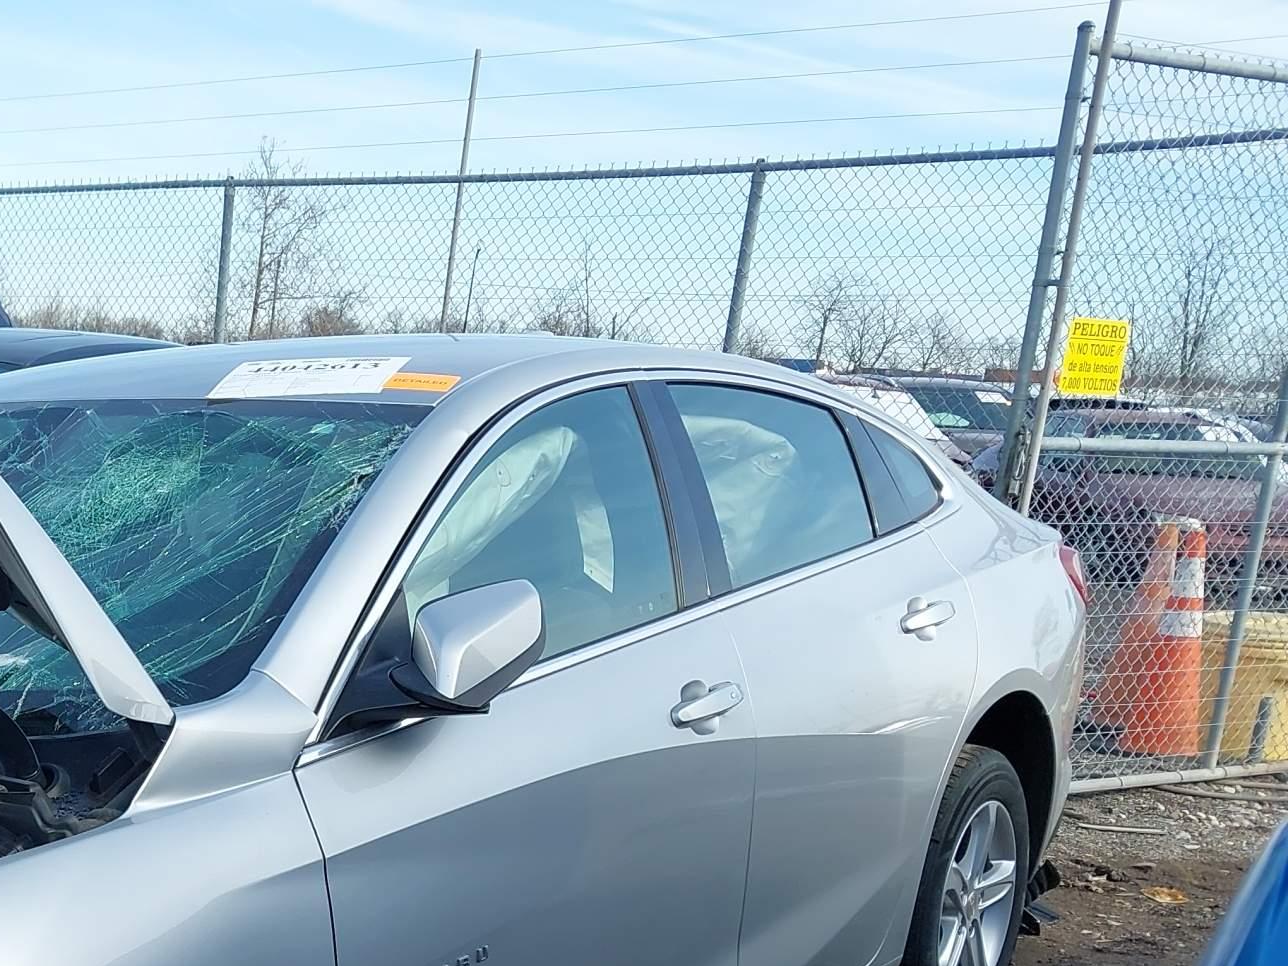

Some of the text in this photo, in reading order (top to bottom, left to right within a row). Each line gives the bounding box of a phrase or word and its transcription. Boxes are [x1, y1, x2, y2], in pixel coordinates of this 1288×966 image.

[1072, 322, 1127, 339] PELIGRO
[1076, 342, 1116, 357] NO TOQUE
[247, 362, 381, 374] 44042613
[1068, 360, 1118, 375] de alta tension
[1083, 377, 1118, 392] VOLTIOS
